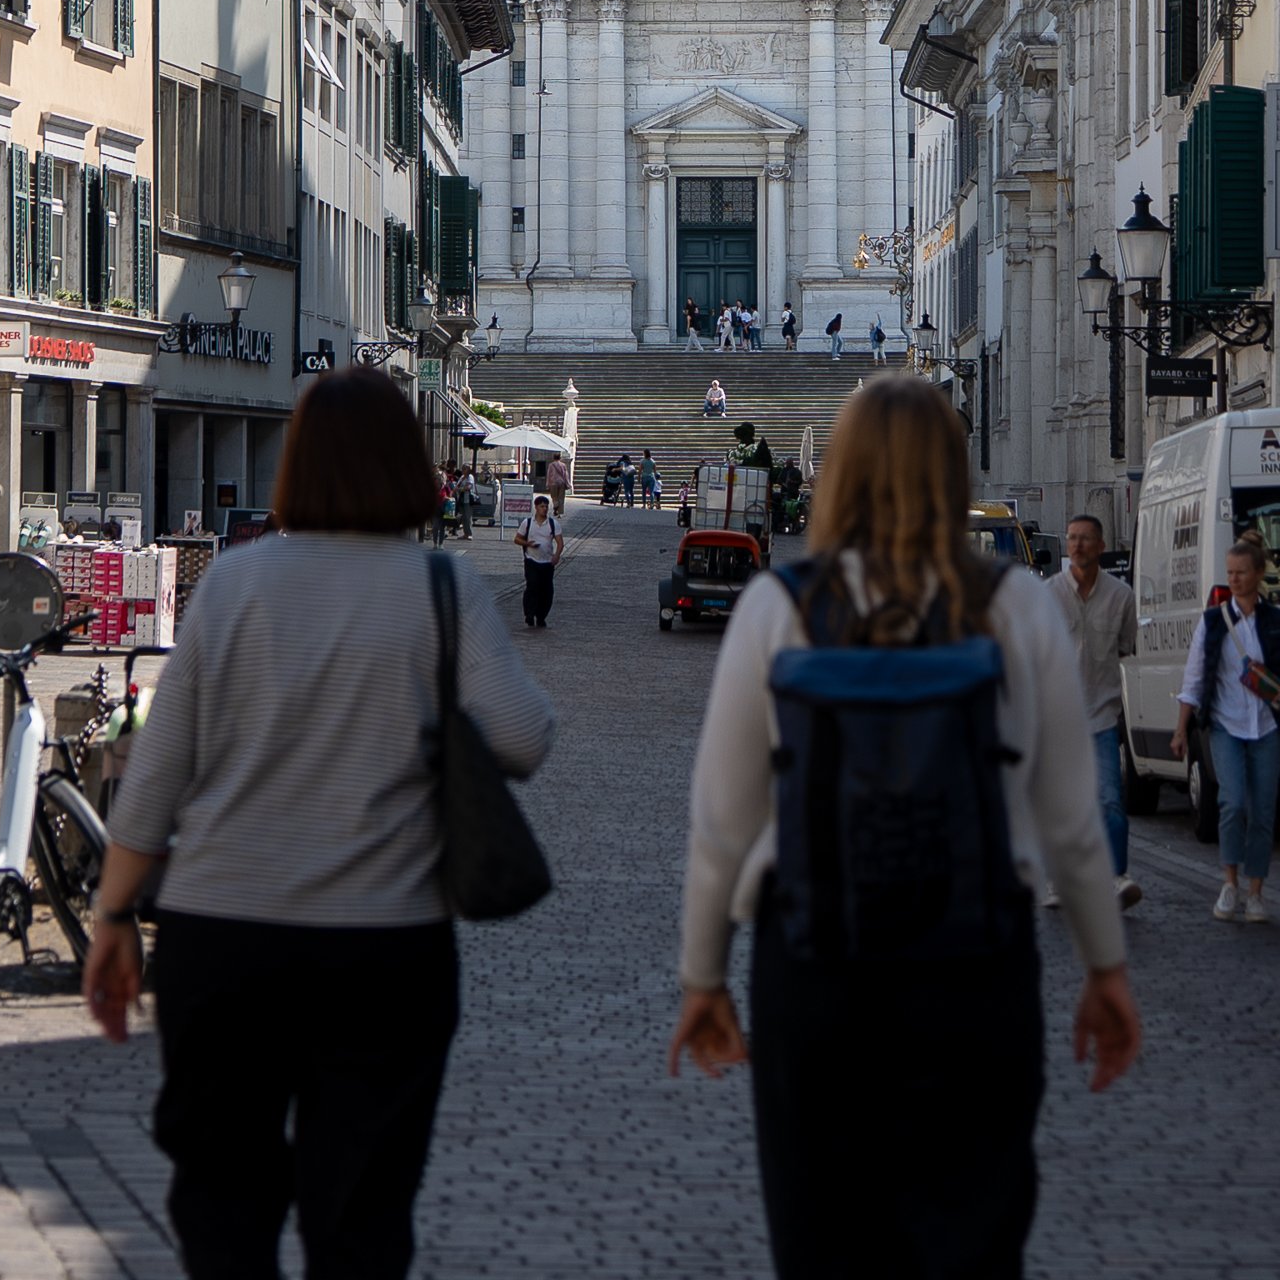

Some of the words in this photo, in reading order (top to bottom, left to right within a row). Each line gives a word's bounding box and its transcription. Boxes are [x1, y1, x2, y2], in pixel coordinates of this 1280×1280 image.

[187, 312, 233, 358] CINEMA
[237, 322, 275, 365] PALACE
[306, 355, 330, 370] C&A
